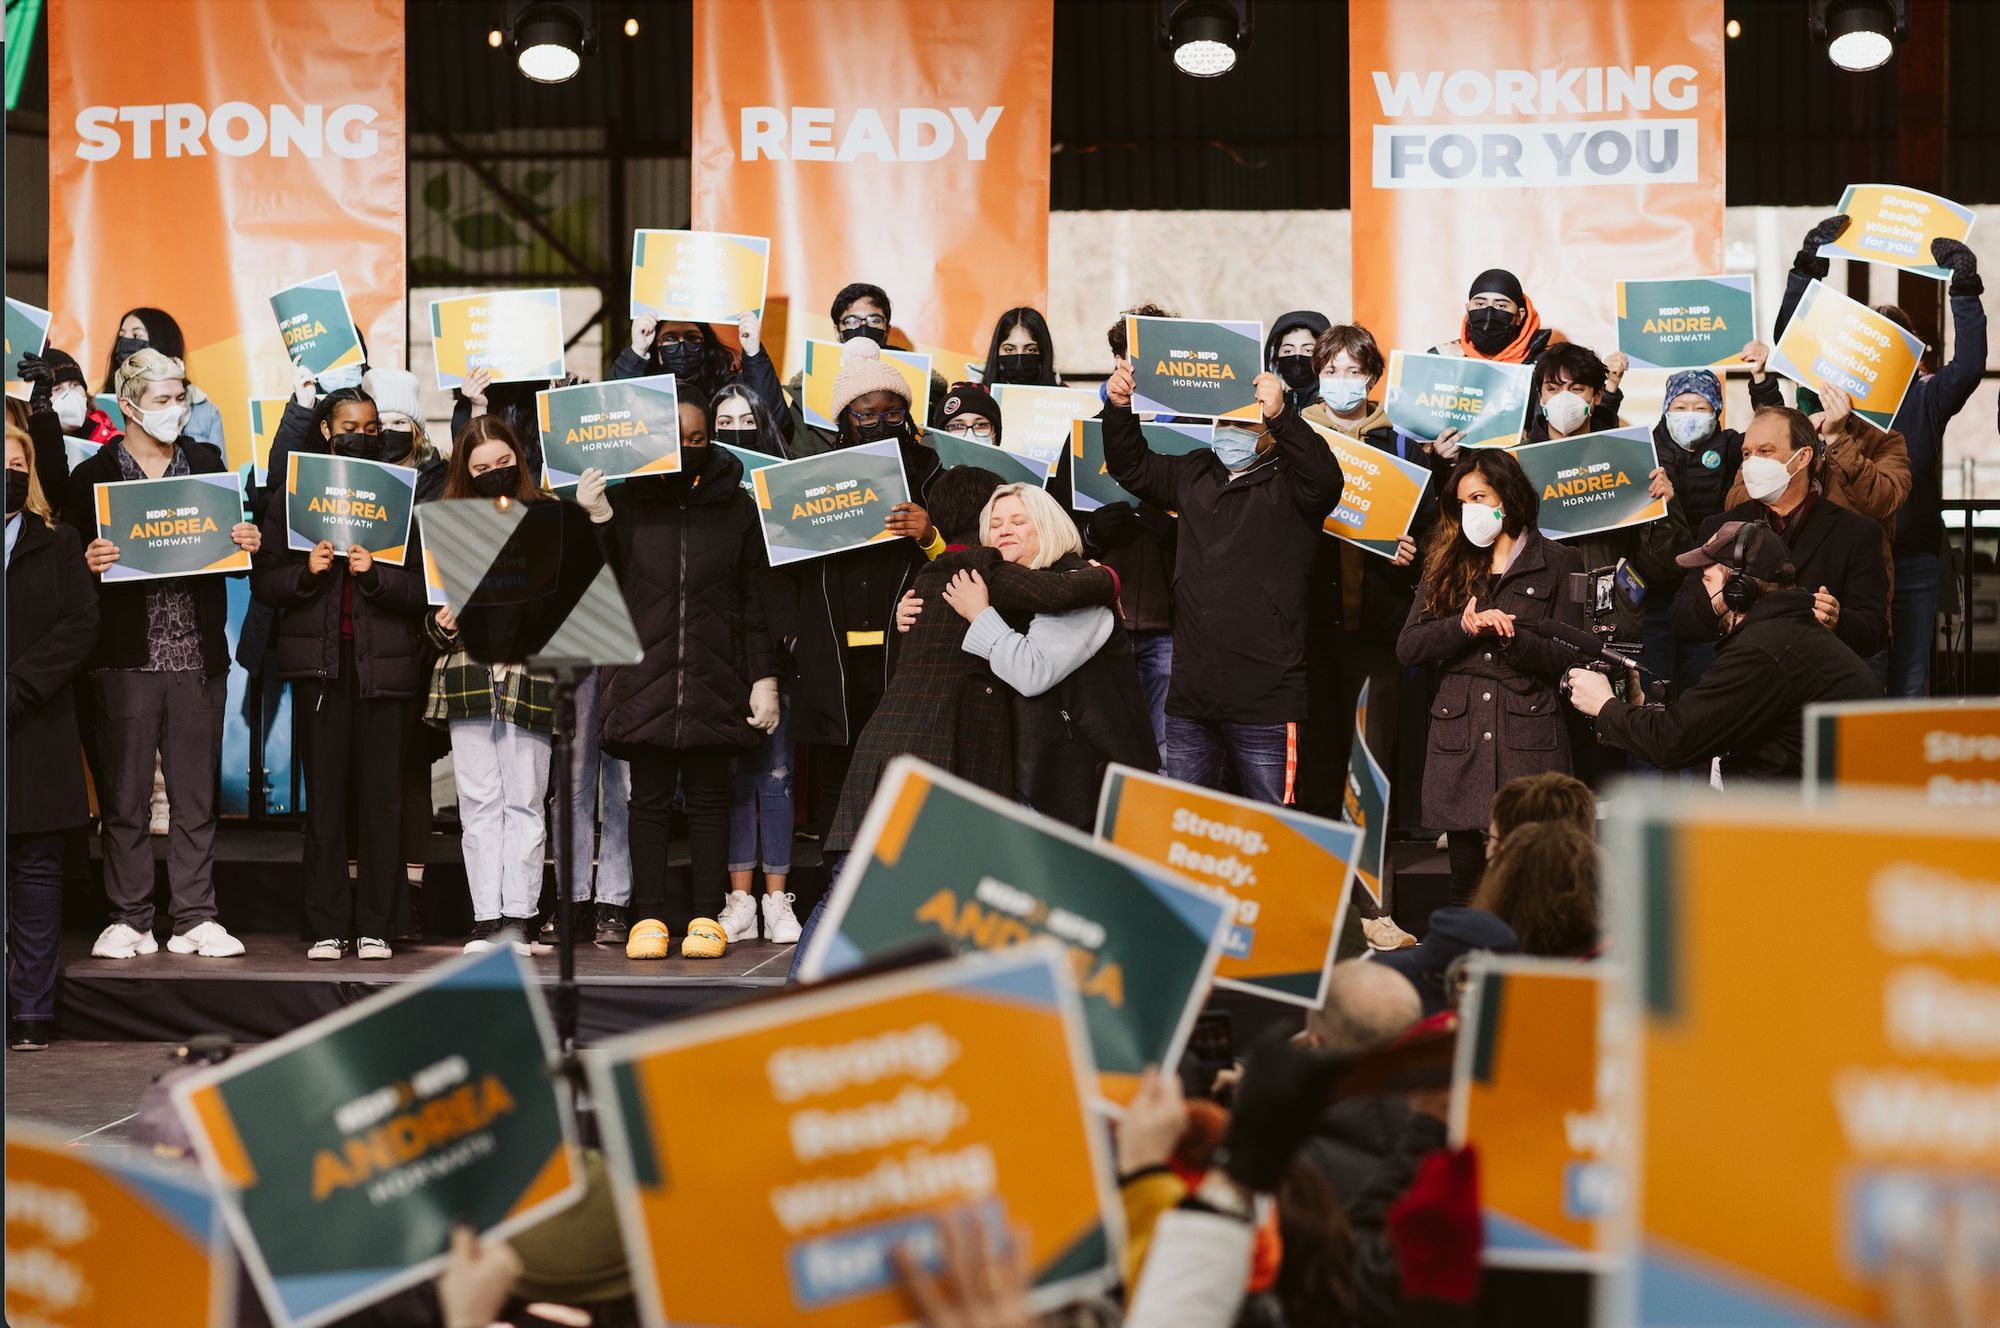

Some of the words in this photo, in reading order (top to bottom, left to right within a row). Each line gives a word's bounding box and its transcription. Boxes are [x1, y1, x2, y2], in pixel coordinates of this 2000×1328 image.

[1372, 64, 1698, 117] WORKING
[75, 101, 378, 162] STRONG
[741, 106, 1005, 162] READY
[1390, 134, 1523, 179] FOR
[1541, 129, 1679, 176] YOU
[1881, 195, 1931, 213] Strong.
[1878, 209, 1924, 226] Ready.
[1865, 221, 1924, 242] Working
[1864, 236, 1884, 247] for
[1887, 240, 1916, 255] you.
[1659, 307, 1680, 316] NDP
[1689, 306, 1710, 315] NPD
[283, 320, 328, 346] DREA
[1642, 316, 1728, 334] ANDREA
[1844, 313, 1891, 348] Strong.
[1659, 333, 1711, 343] HORWATH
[1838, 331, 1881, 363] Ready.
[1169, 349, 1190, 359] NDP
[1198, 350, 1218, 360] NPD
[1823, 341, 1878, 383] Working
[1155, 360, 1236, 380] ANDREA
[1817, 360, 1838, 378] for
[1840, 374, 1866, 396] you.
[1172, 379, 1221, 389] HORWATH
[1414, 391, 1497, 415] ANDREA
[580, 413, 600, 424] NDP
[609, 410, 631, 421] NPD
[1431, 409, 1480, 423] HORWATH
[565, 420, 649, 444] ANDREA
[582, 439, 632, 452] HORWATH
[1557, 468, 1579, 480] NDP
[1587, 462, 1611, 474] NPD
[804, 488, 826, 499] NDP
[835, 479, 858, 491] NPD
[1344, 472, 1372, 491] ady.
[1542, 471, 1632, 500] ANDREA
[325, 486, 347, 496] NDP
[355, 489, 376, 501] NPD
[791, 487, 880, 520] ANDREA
[1562, 490, 1616, 507] HORWATH
[146, 510, 167, 520] NDP
[176, 506, 199, 516] NPD
[307, 496, 388, 522] ANDREA
[811, 507, 864, 526] HORWATH
[129, 516, 218, 540] ANDREA
[322, 515, 373, 529] HORWATH
[148, 536, 201, 548] HORWATH
[1172, 807, 1269, 856] Strong.
[1168, 842, 1257, 887] Ready.
[915, 888, 1125, 1008] ANDEA
